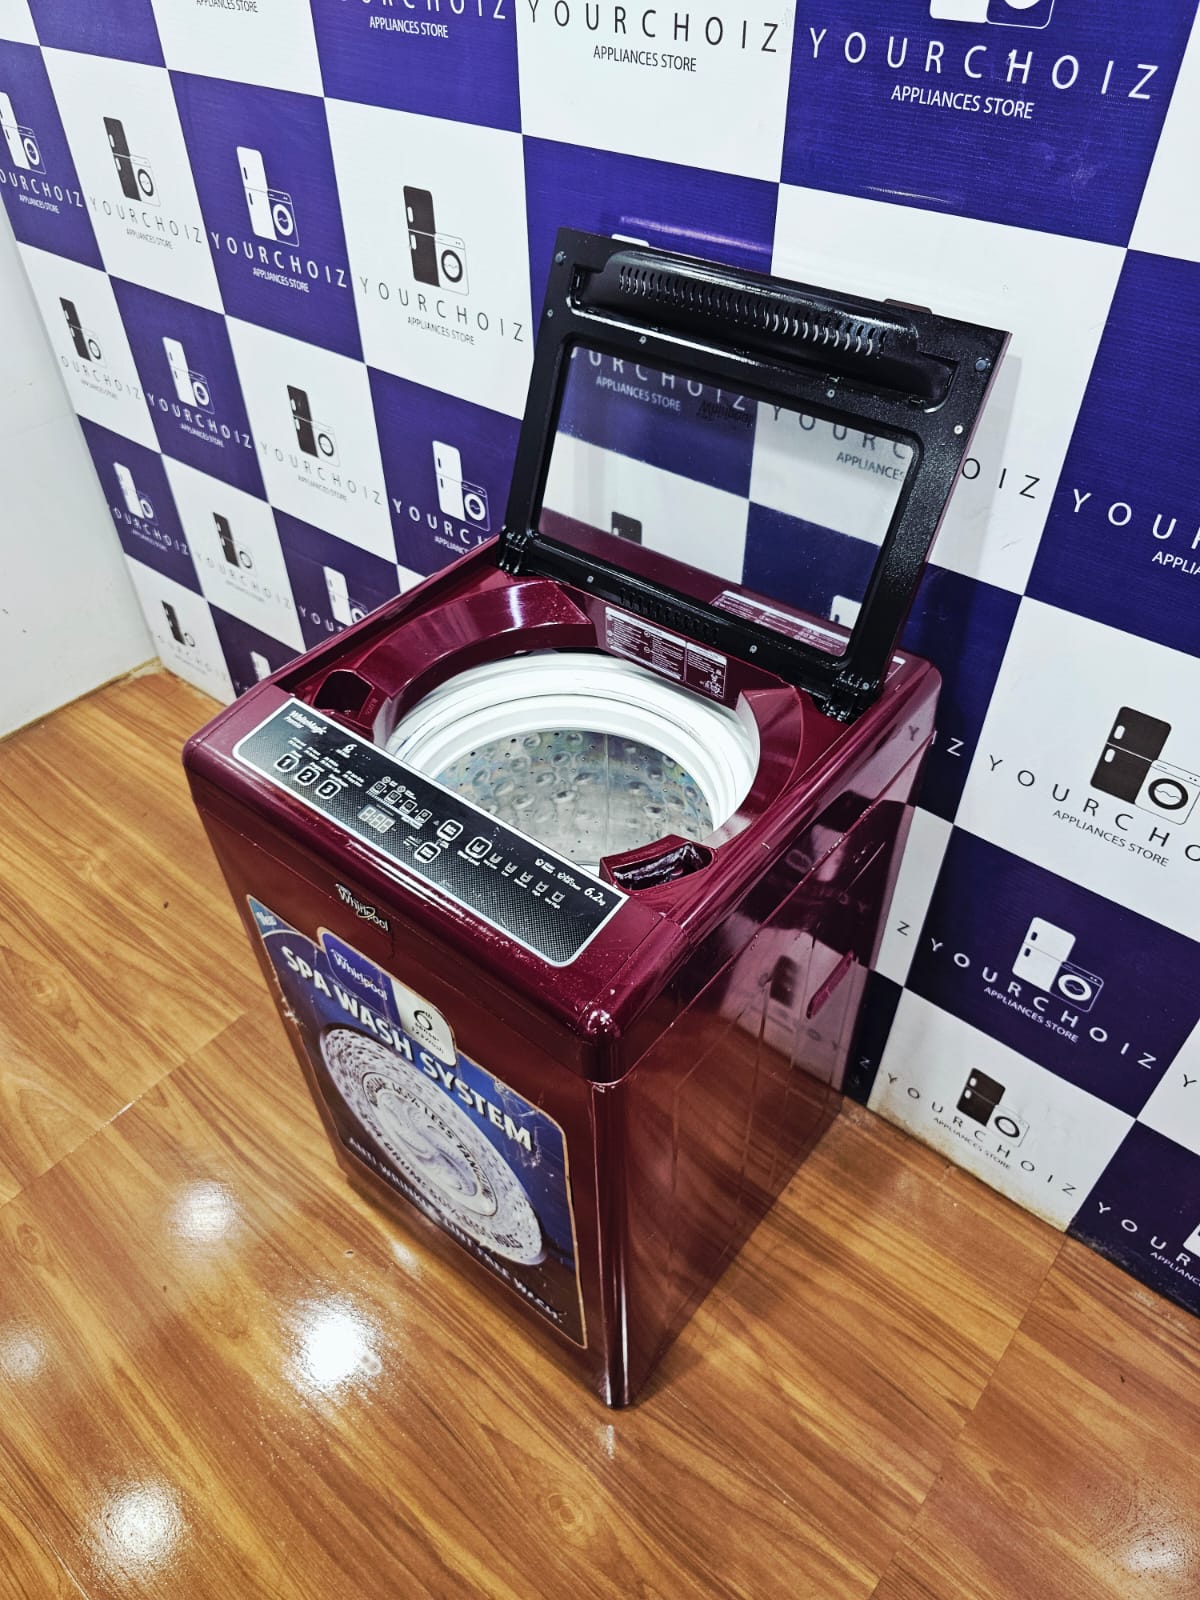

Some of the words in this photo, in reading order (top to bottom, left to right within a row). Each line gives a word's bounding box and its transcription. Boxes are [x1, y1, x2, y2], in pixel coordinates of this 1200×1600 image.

[369, 16, 419, 34] APPLIANCES
[420, 22, 448, 38] STORE
[528, 0, 779, 52] YOURCHOIZ
[593, 45, 658, 67] APPLIANCES
[661, 54, 697, 72] STORE
[809, 27, 1159, 100] YOURCHOIZ
[891, 85, 981, 112] APPLIANCES
[983, 97, 1035, 120] STORE
[0, 168, 83, 207] OURCHOIZ
[90, 196, 202, 244] YOURCHOIZ
[211, 232, 347, 288] YOURCHOIZ
[253, 267, 289, 286] APPLIANCES
[289, 279, 310, 293] STORE
[360, 276, 524, 342] YOURCHOIZ
[408, 316, 450, 338] APPLIANCES
[451, 329, 475, 345] STORE
[61, 355, 141, 400] OURCHOIZ
[596, 376, 650, 402] APPLIANCES
[651, 393, 681, 412] STORE
[148, 392, 252, 449] YOURCHOIZ
[260, 442, 382, 505] YOURCHOIZ
[113, 507, 189, 555] OURCHOIZ
[1151, 551, 1200, 575] APPLIA
[283, 759, 293, 767] 1
[302, 772, 312, 781] 2
[323, 785, 334, 794] 3
[989, 755, 1200, 861] YOURCHO
[1052, 810, 1125, 848] APPLIANCES
[1128, 842, 1170, 867] STORE
[335, 884, 389, 932] Whirlpool
[330, 949, 388, 1000] Whirlpool
[930, 938, 1157, 1069] YOURCHOIZ
[984, 986, 1045, 1026] APPLIANCES
[1045, 1018, 1080, 1043] STORE
[281, 946, 333, 999] SPA
[334, 984, 413, 1061] WASH
[419, 1051, 534, 1151] SYSTEM
[887, 1072, 1077, 1196] YOURCHOIZ
[933, 1116, 984, 1153] APPLIANCES
[985, 1149, 1011, 1170] STORE
[1150, 1252, 1200, 1286] APPLIANC
